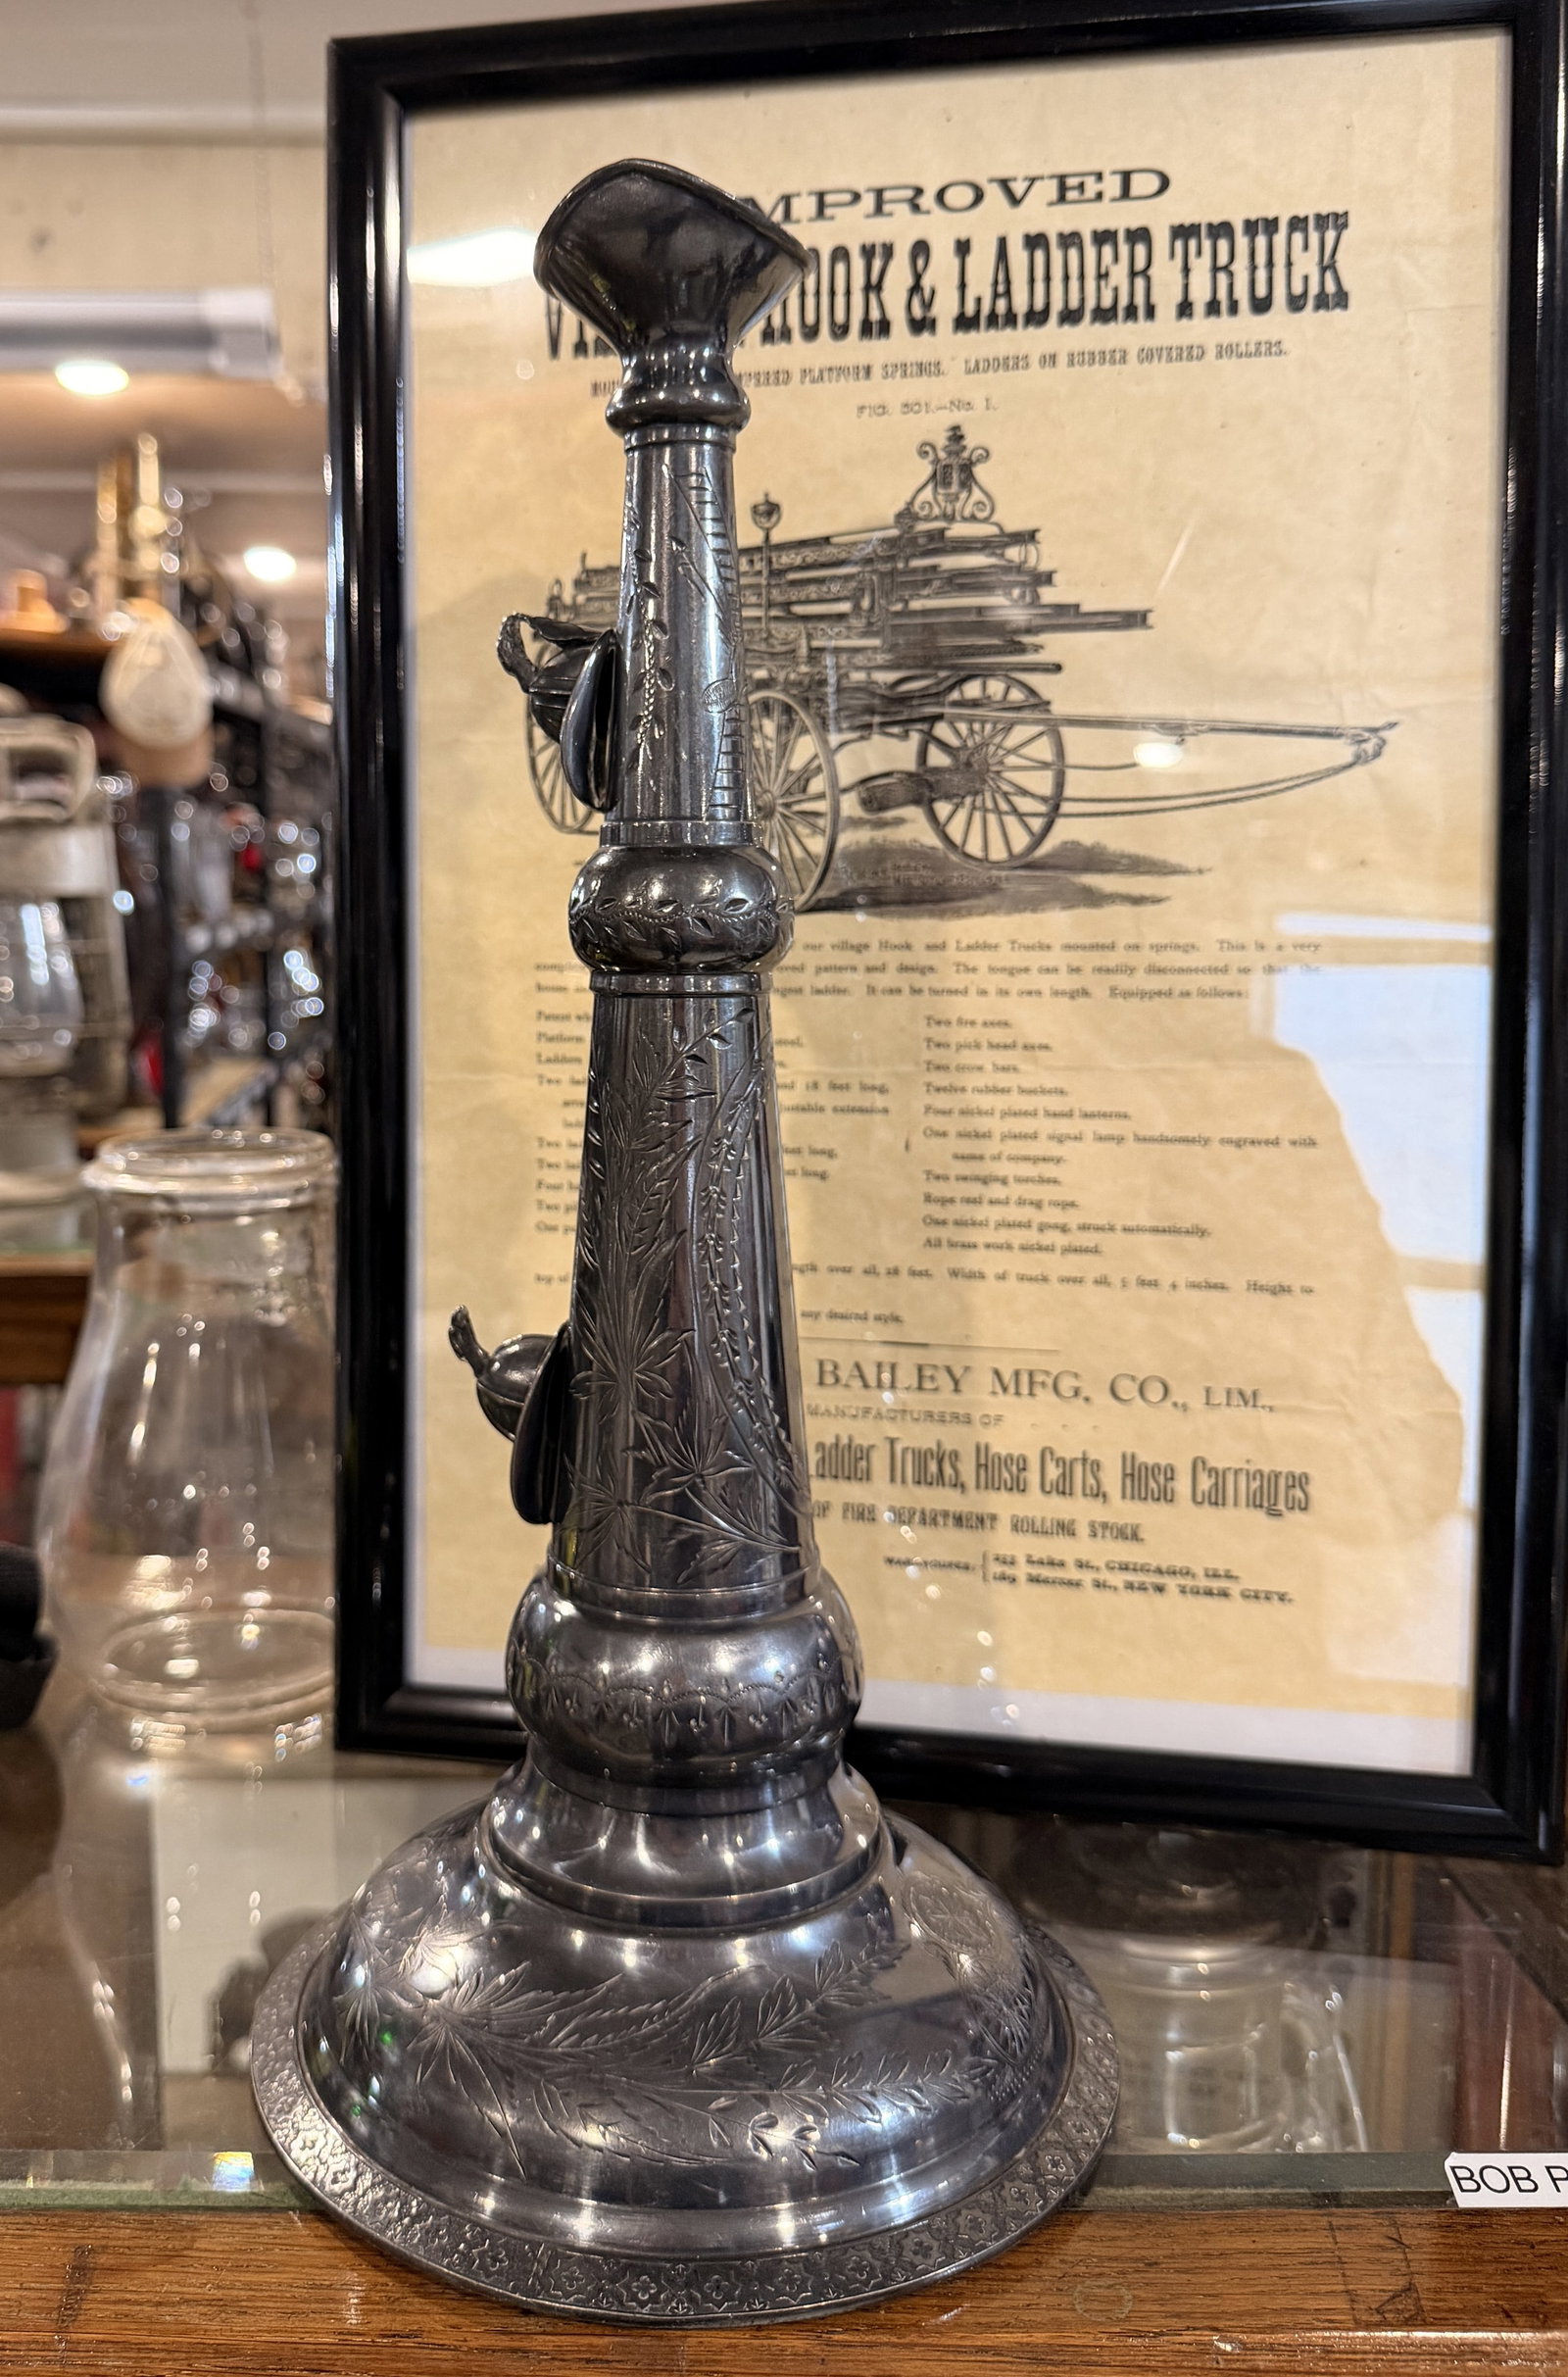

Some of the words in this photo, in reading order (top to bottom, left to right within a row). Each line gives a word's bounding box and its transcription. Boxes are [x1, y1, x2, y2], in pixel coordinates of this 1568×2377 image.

[735, 169, 1170, 223] MPROVED
[905, 238, 937, 338] &
[953, 226, 1155, 333] LADDER
[1169, 210, 1349, 322] TRUCK
[800, 364, 873, 385] PLATFORM
[881, 358, 948, 380] SPRINGS.
[963, 353, 1031, 375] LADDERS
[1039, 352, 1057, 369] ON
[1066, 348, 1128, 368] RUBBER
[1137, 344, 1205, 366] COVERED
[1215, 339, 1291, 361] ROLLERS.
[829, 939, 871, 955] village
[878, 939, 912, 952] Hook
[924, 939, 947, 952] and
[955, 939, 1001, 953] Ladder
[1006, 939, 1053, 953] Trucks
[1060, 939, 1116, 953] mounted
[1123, 942, 1141, 953] on
[1149, 940, 1200, 956] springs.
[1216, 939, 1247, 953] This
[1276, 943, 1284, 953] a
[1291, 942, 1321, 956] very
[814, 963, 858, 976] pattern
[864, 963, 886, 974] and
[896, 962, 938, 976] design.
[953, 962, 978, 974] The
[988, 963, 1031, 977] tongue
[1037, 965, 1059, 975] can
[1066, 963, 1083, 975] be
[1091, 963, 1137, 977] readily
[1143, 963, 1229, 975] disconnected
[1237, 966, 1250, 975] so
[1262, 963, 1289, 975] that
[810, 984, 851, 997] ladder.
[882, 987, 903, 996] can
[909, 984, 924, 997] be
[928, 985, 968, 997] turned
[1016, 988, 1043, 998] own
[1050, 985, 1093, 1001] length.
[1108, 984, 1173, 1002] Equipped
[924, 1015, 953, 1028] Two
[956, 1015, 978, 1028] fire
[981, 1017, 1013, 1029] axes.
[924, 1037, 951, 1051] Two
[955, 1038, 982, 1053] pick
[986, 1038, 1018, 1051] head
[1021, 1041, 1054, 1053] axes.
[924, 1060, 951, 1073] Two
[828, 1081, 851, 1091] feet
[924, 1081, 967, 1095] Twelve
[971, 1084, 1012, 1096] rubber
[1017, 1084, 1069, 1097] buckets.
[831, 1105, 890, 1115] extension
[923, 1104, 954, 1116] Four
[957, 1105, 995, 1117] nickel
[1000, 1106, 1039, 1121] plated
[1043, 1107, 1074, 1119] hand
[1078, 1107, 1132, 1121] lanterns.
[922, 1126, 950, 1139] One
[955, 1127, 993, 1140] nickel
[1000, 1129, 1039, 1144] plated
[1046, 1129, 1084, 1145] signal
[1093, 1130, 1126, 1145] lamp
[1132, 1131, 1211, 1148] handsomely
[1218, 1135, 1281, 1150] engraved
[1287, 1135, 1318, 1149] with
[952, 1152, 986, 1163] name
[989, 1151, 1004, 1163] of
[1005, 1153, 1067, 1165] company.
[924, 1169, 950, 1183] Two
[923, 1192, 957, 1208] Rope
[987, 1195, 1010, 1207] and
[1014, 1195, 1044, 1211] drag
[922, 1213, 949, 1227] One
[952, 1215, 990, 1228] nickel
[994, 1217, 1032, 1231] plated
[1077, 1220, 1116, 1234] struck
[922, 1236, 943, 1250] All
[946, 1238, 978, 1251] brass
[983, 1239, 1013, 1253] work
[1018, 1241, 1055, 1255] nickel
[1060, 1243, 1103, 1257] plated.
[826, 1264, 854, 1275] over
[947, 1266, 986, 1280] Width
[994, 1268, 1007, 1281] of
[1015, 1270, 1050, 1283] track
[1056, 1273, 1086, 1285] over
[1246, 1278, 1294, 1295] Height
[815, 1359, 971, 1394] BAILEY
[990, 1365, 1092, 1404] MFG.
[1108, 1372, 1191, 1411] CO.,
[807, 1403, 972, 1425] MANUFACTURERS
[980, 1412, 1005, 1426] OF
[809, 1433, 877, 1483] adder
[885, 1435, 965, 1494] Trucks,
[974, 1440, 1028, 1494] Hose
[1039, 1445, 1107, 1505] Carts,
[1120, 1450, 1176, 1504] Hose
[1190, 1455, 1311, 1517] Carriages
[842, 1502, 877, 1523] FIRE
[886, 1504, 1000, 1531] DEPARTMENT
[1010, 1513, 1077, 1538] ROLLING
[1088, 1519, 1147, 1543] STOCK.
[1104, 1559, 1197, 1579] CHICAGO,
[1123, 1578, 1168, 1595] NEW
[1175, 1582, 1232, 1601] YORK
[1449, 2164, 1540, 2194] BOB
